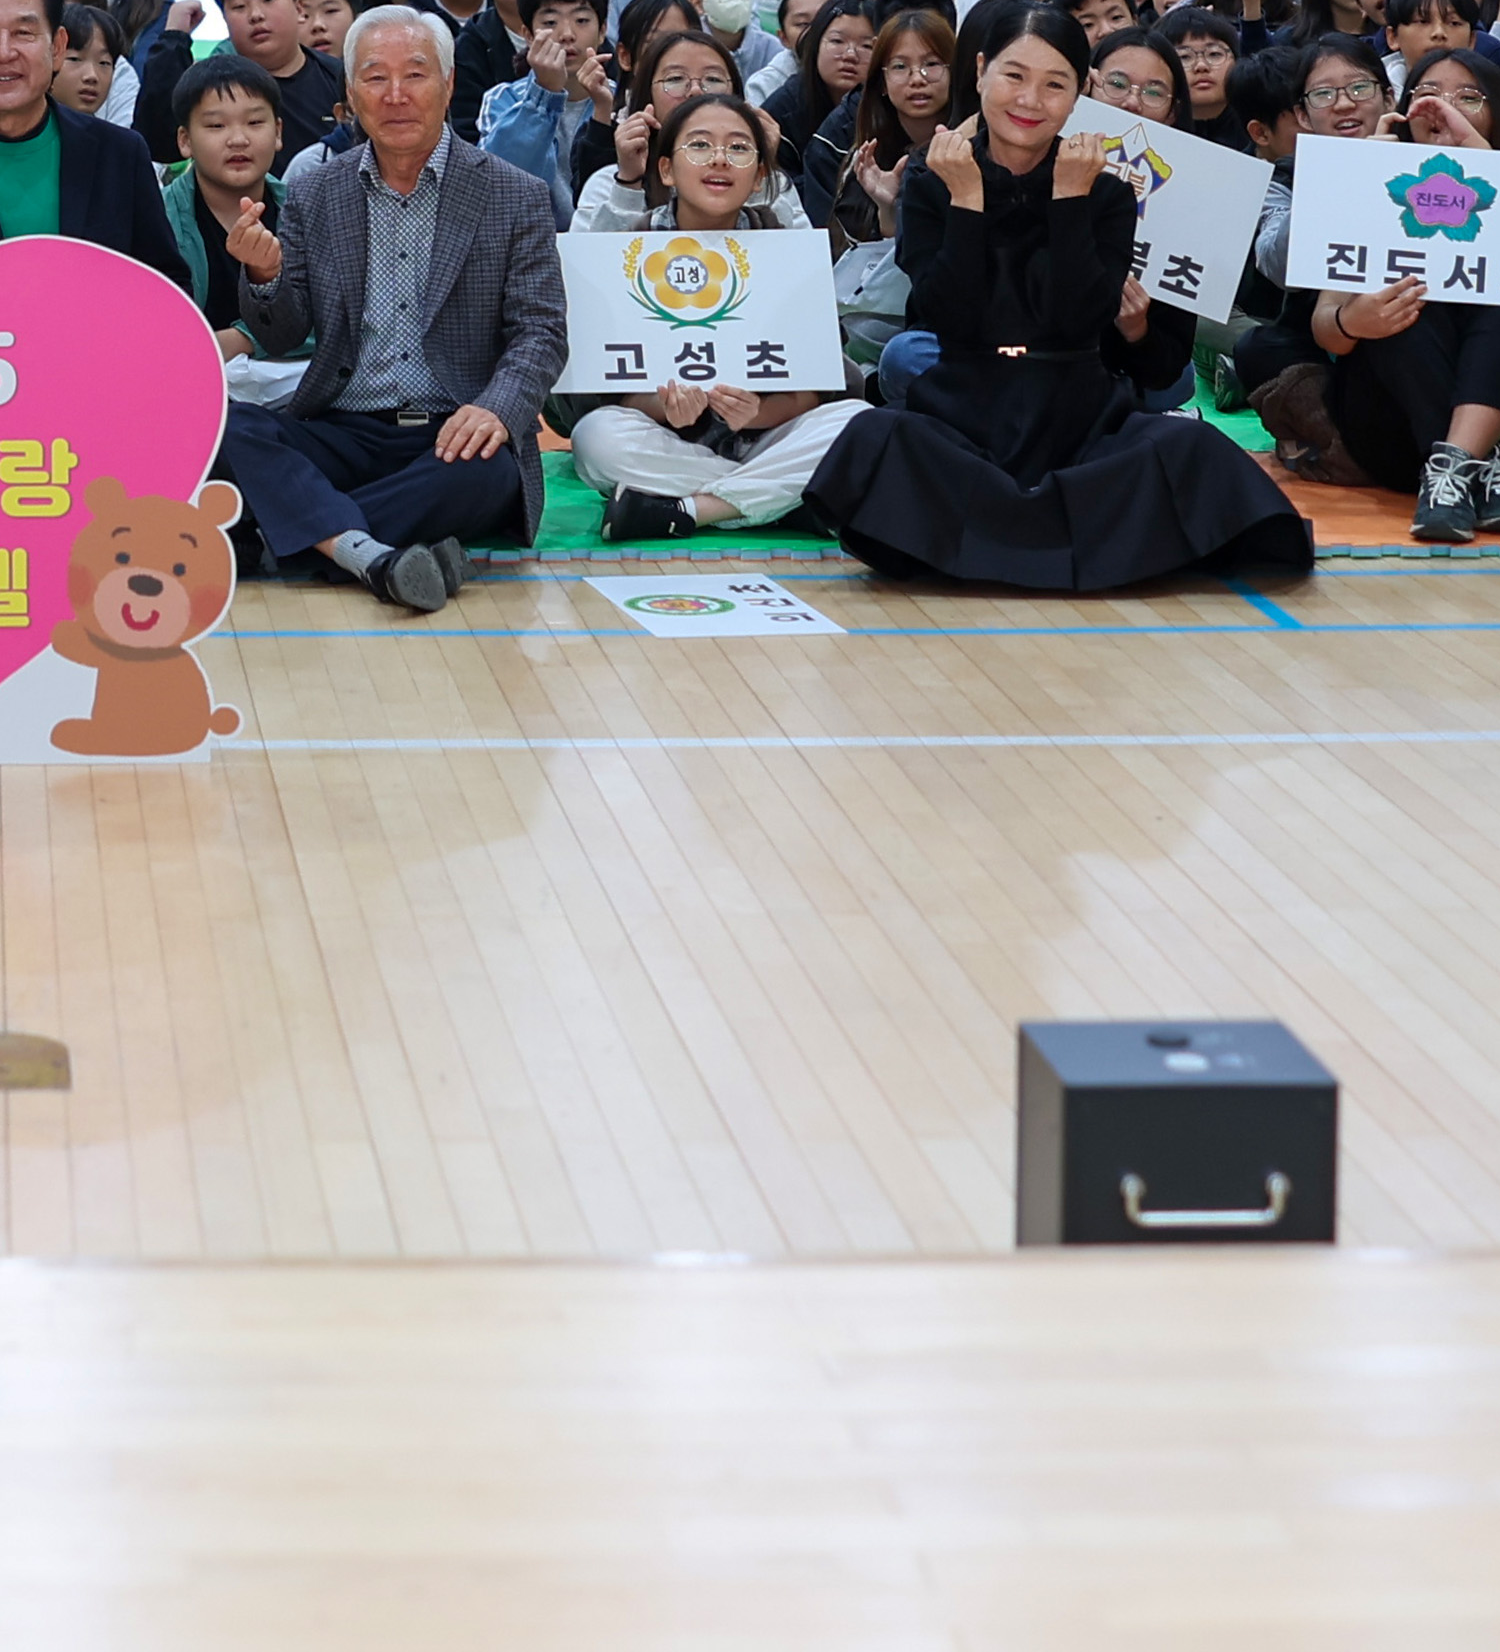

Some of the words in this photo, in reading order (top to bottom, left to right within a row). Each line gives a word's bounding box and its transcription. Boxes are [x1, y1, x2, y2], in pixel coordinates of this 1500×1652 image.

[1416, 192, 1466, 210] 진도서
[674, 266, 699, 284] 고성
[604, 340, 790, 381] 고성초
